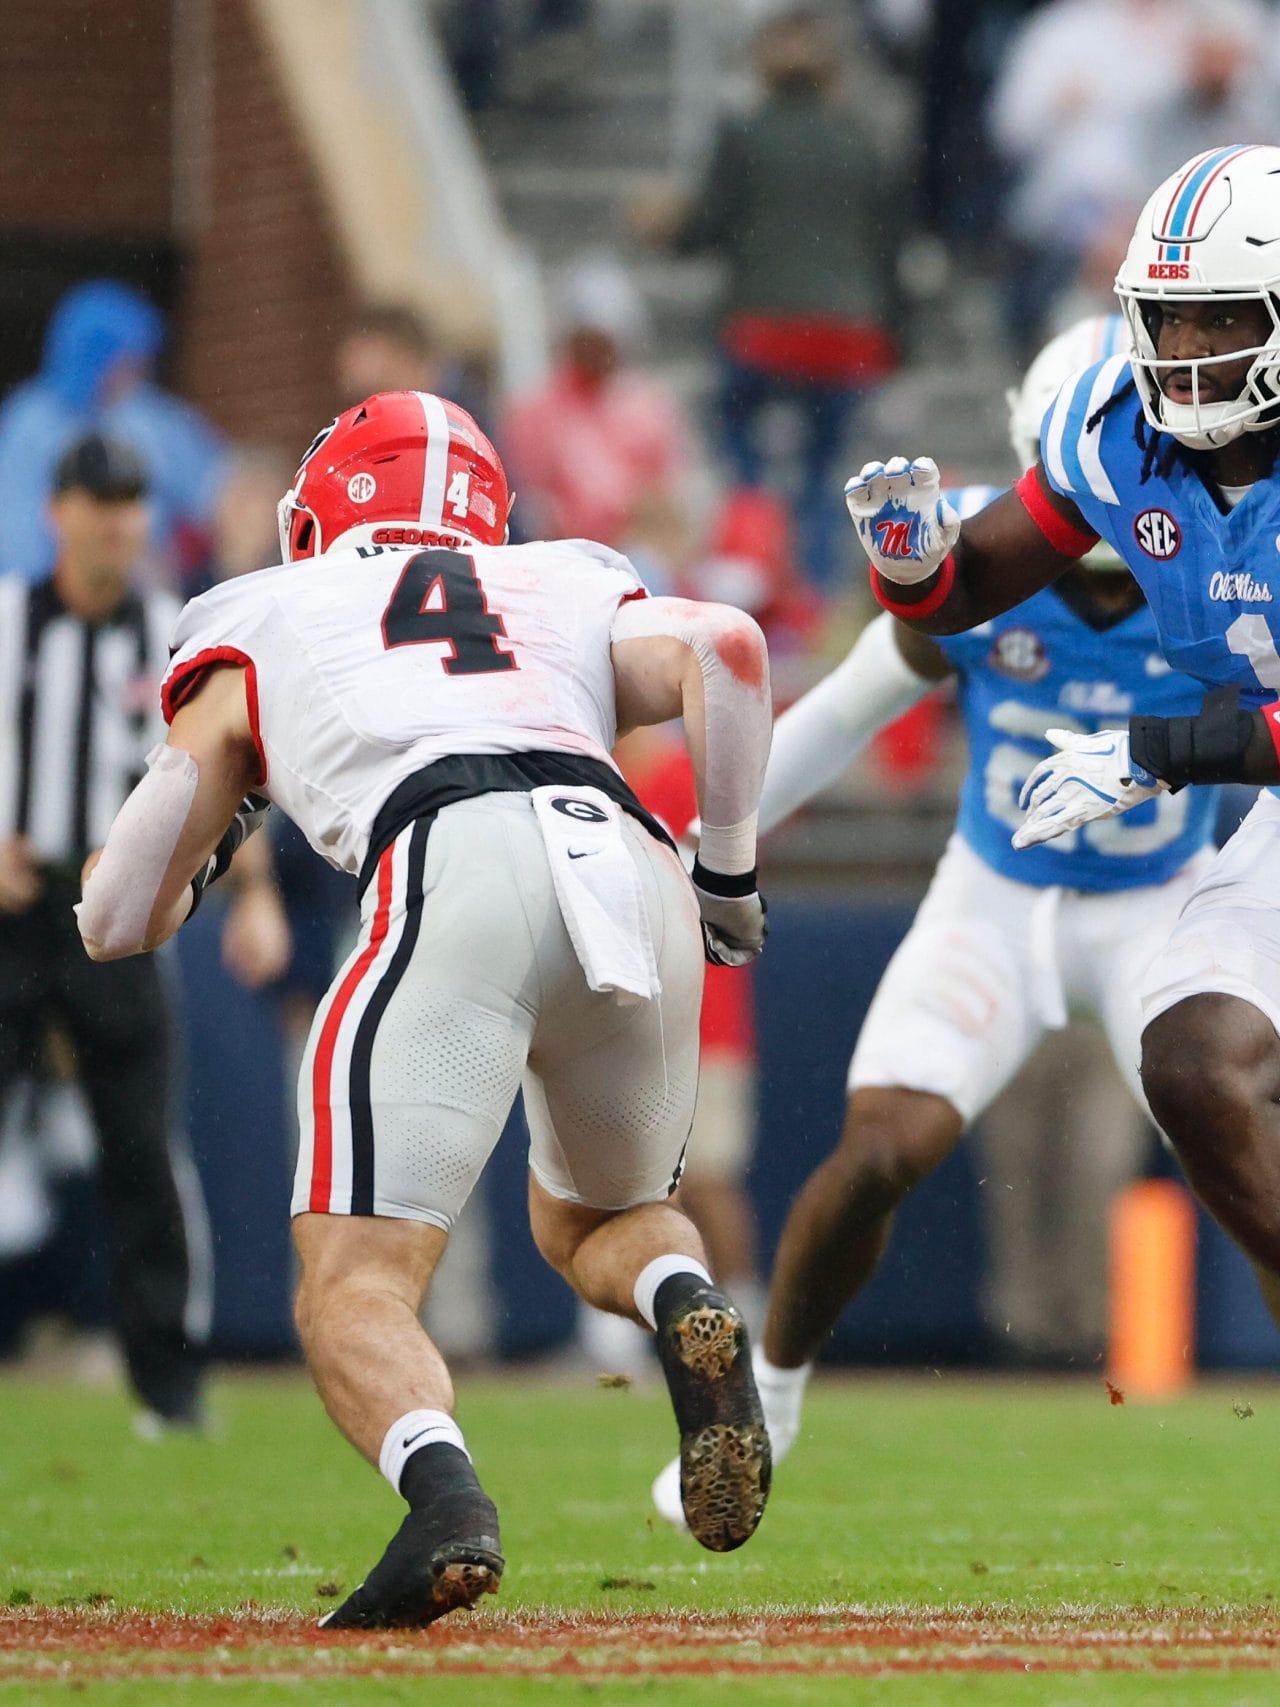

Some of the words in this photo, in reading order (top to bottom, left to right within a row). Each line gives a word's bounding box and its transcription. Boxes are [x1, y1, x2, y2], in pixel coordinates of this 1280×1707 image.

[1148, 264, 1190, 279] REBS
[350, 475, 373, 500] SEC
[447, 471, 471, 518] 4
[1136, 511, 1177, 557] SEC
[1209, 571, 1236, 601] Ole
[1234, 573, 1273, 602] Miss
[381, 549, 521, 676] 4
[550, 798, 609, 822] G
